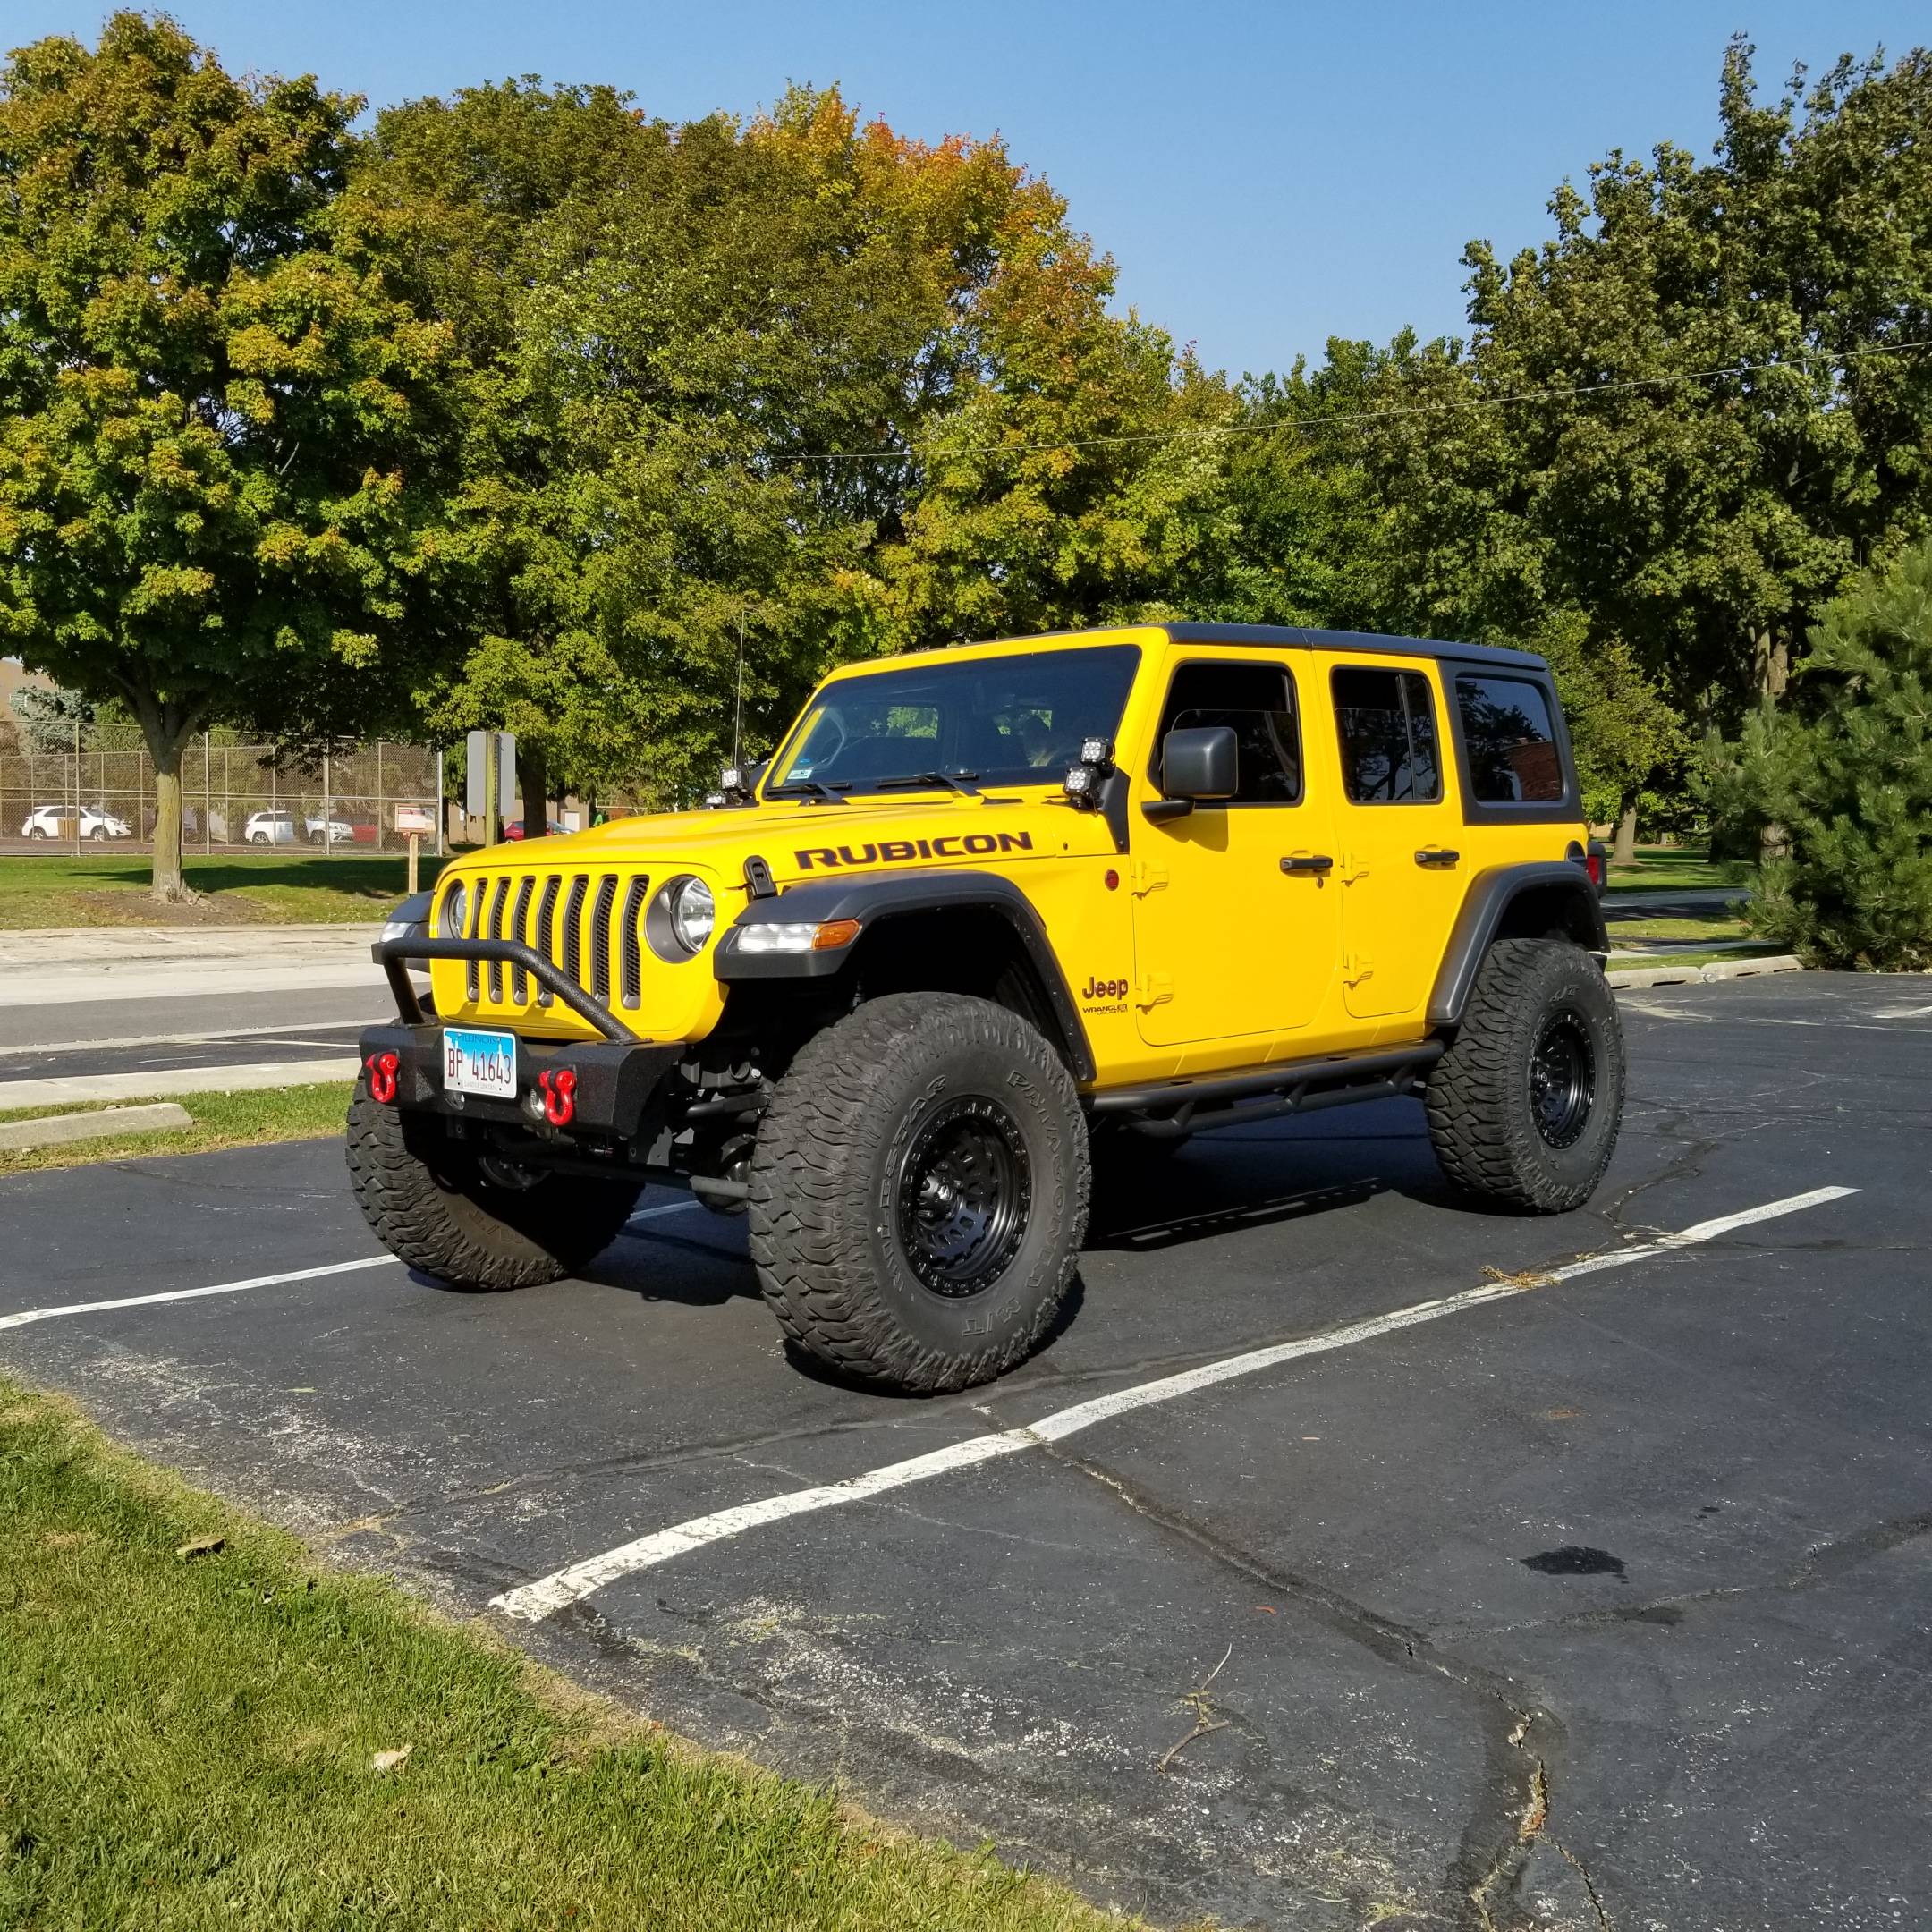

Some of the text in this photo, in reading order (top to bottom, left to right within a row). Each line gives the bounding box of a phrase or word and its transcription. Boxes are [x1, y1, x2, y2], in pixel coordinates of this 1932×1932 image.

[793, 831, 1034, 870] RUBICON
[1082, 976, 1129, 1000] Jeep
[1082, 1004, 1128, 1014] WRANGLER
[462, 1034, 496, 1045] ILLINOIS
[447, 1047, 512, 1084] BP 41643
